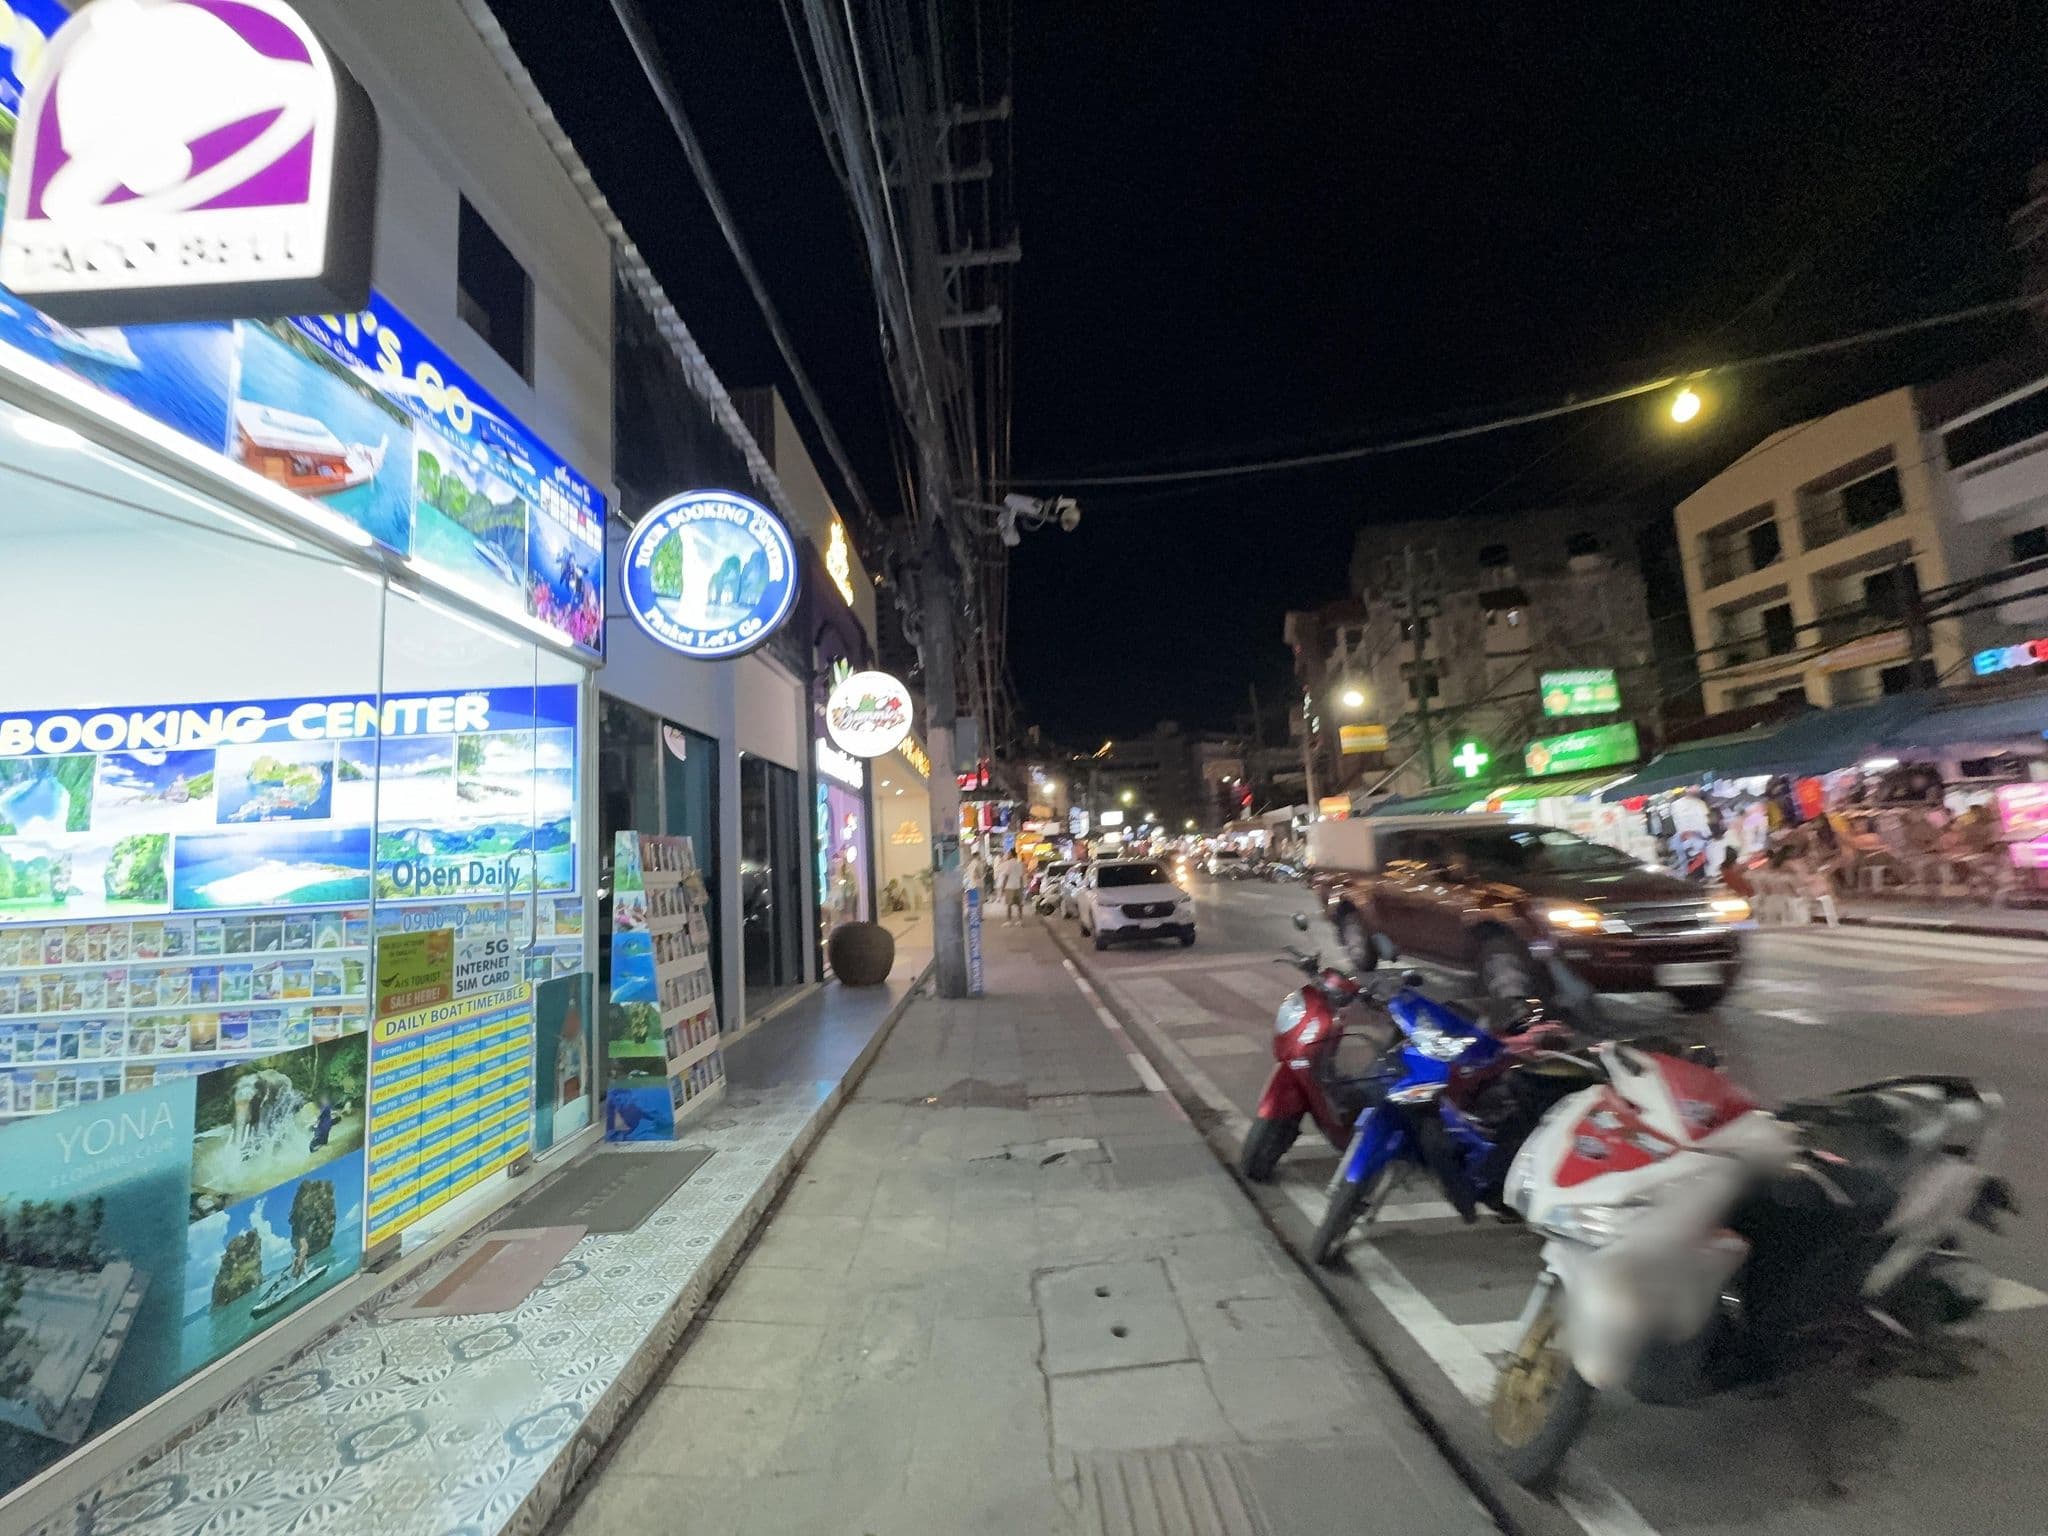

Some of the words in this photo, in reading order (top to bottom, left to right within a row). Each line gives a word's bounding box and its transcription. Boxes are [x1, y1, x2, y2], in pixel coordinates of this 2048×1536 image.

[415, 360, 473, 434] GO
[667, 502, 749, 529] BOOKING
[738, 618, 763, 637] Go
[0, 707, 267, 757] BOOKING
[287, 695, 490, 739] CENTER
[392, 861, 462, 896] Open
[469, 859, 521, 890] Daily
[485, 939, 509, 956] 5G
[456, 956, 510, 977] INTERNET
[456, 978, 479, 993] SIM
[483, 971, 511, 987] CARD
[386, 1012, 428, 1037] DAILY
[431, 1003, 463, 1021] BOAT
[466, 987, 524, 1010] TIMETABLE
[390, 992, 411, 1009] SALE
[381, 1045, 402, 1056] From
[408, 1041, 417, 1049] to
[56, 1102, 174, 1164] YONA
